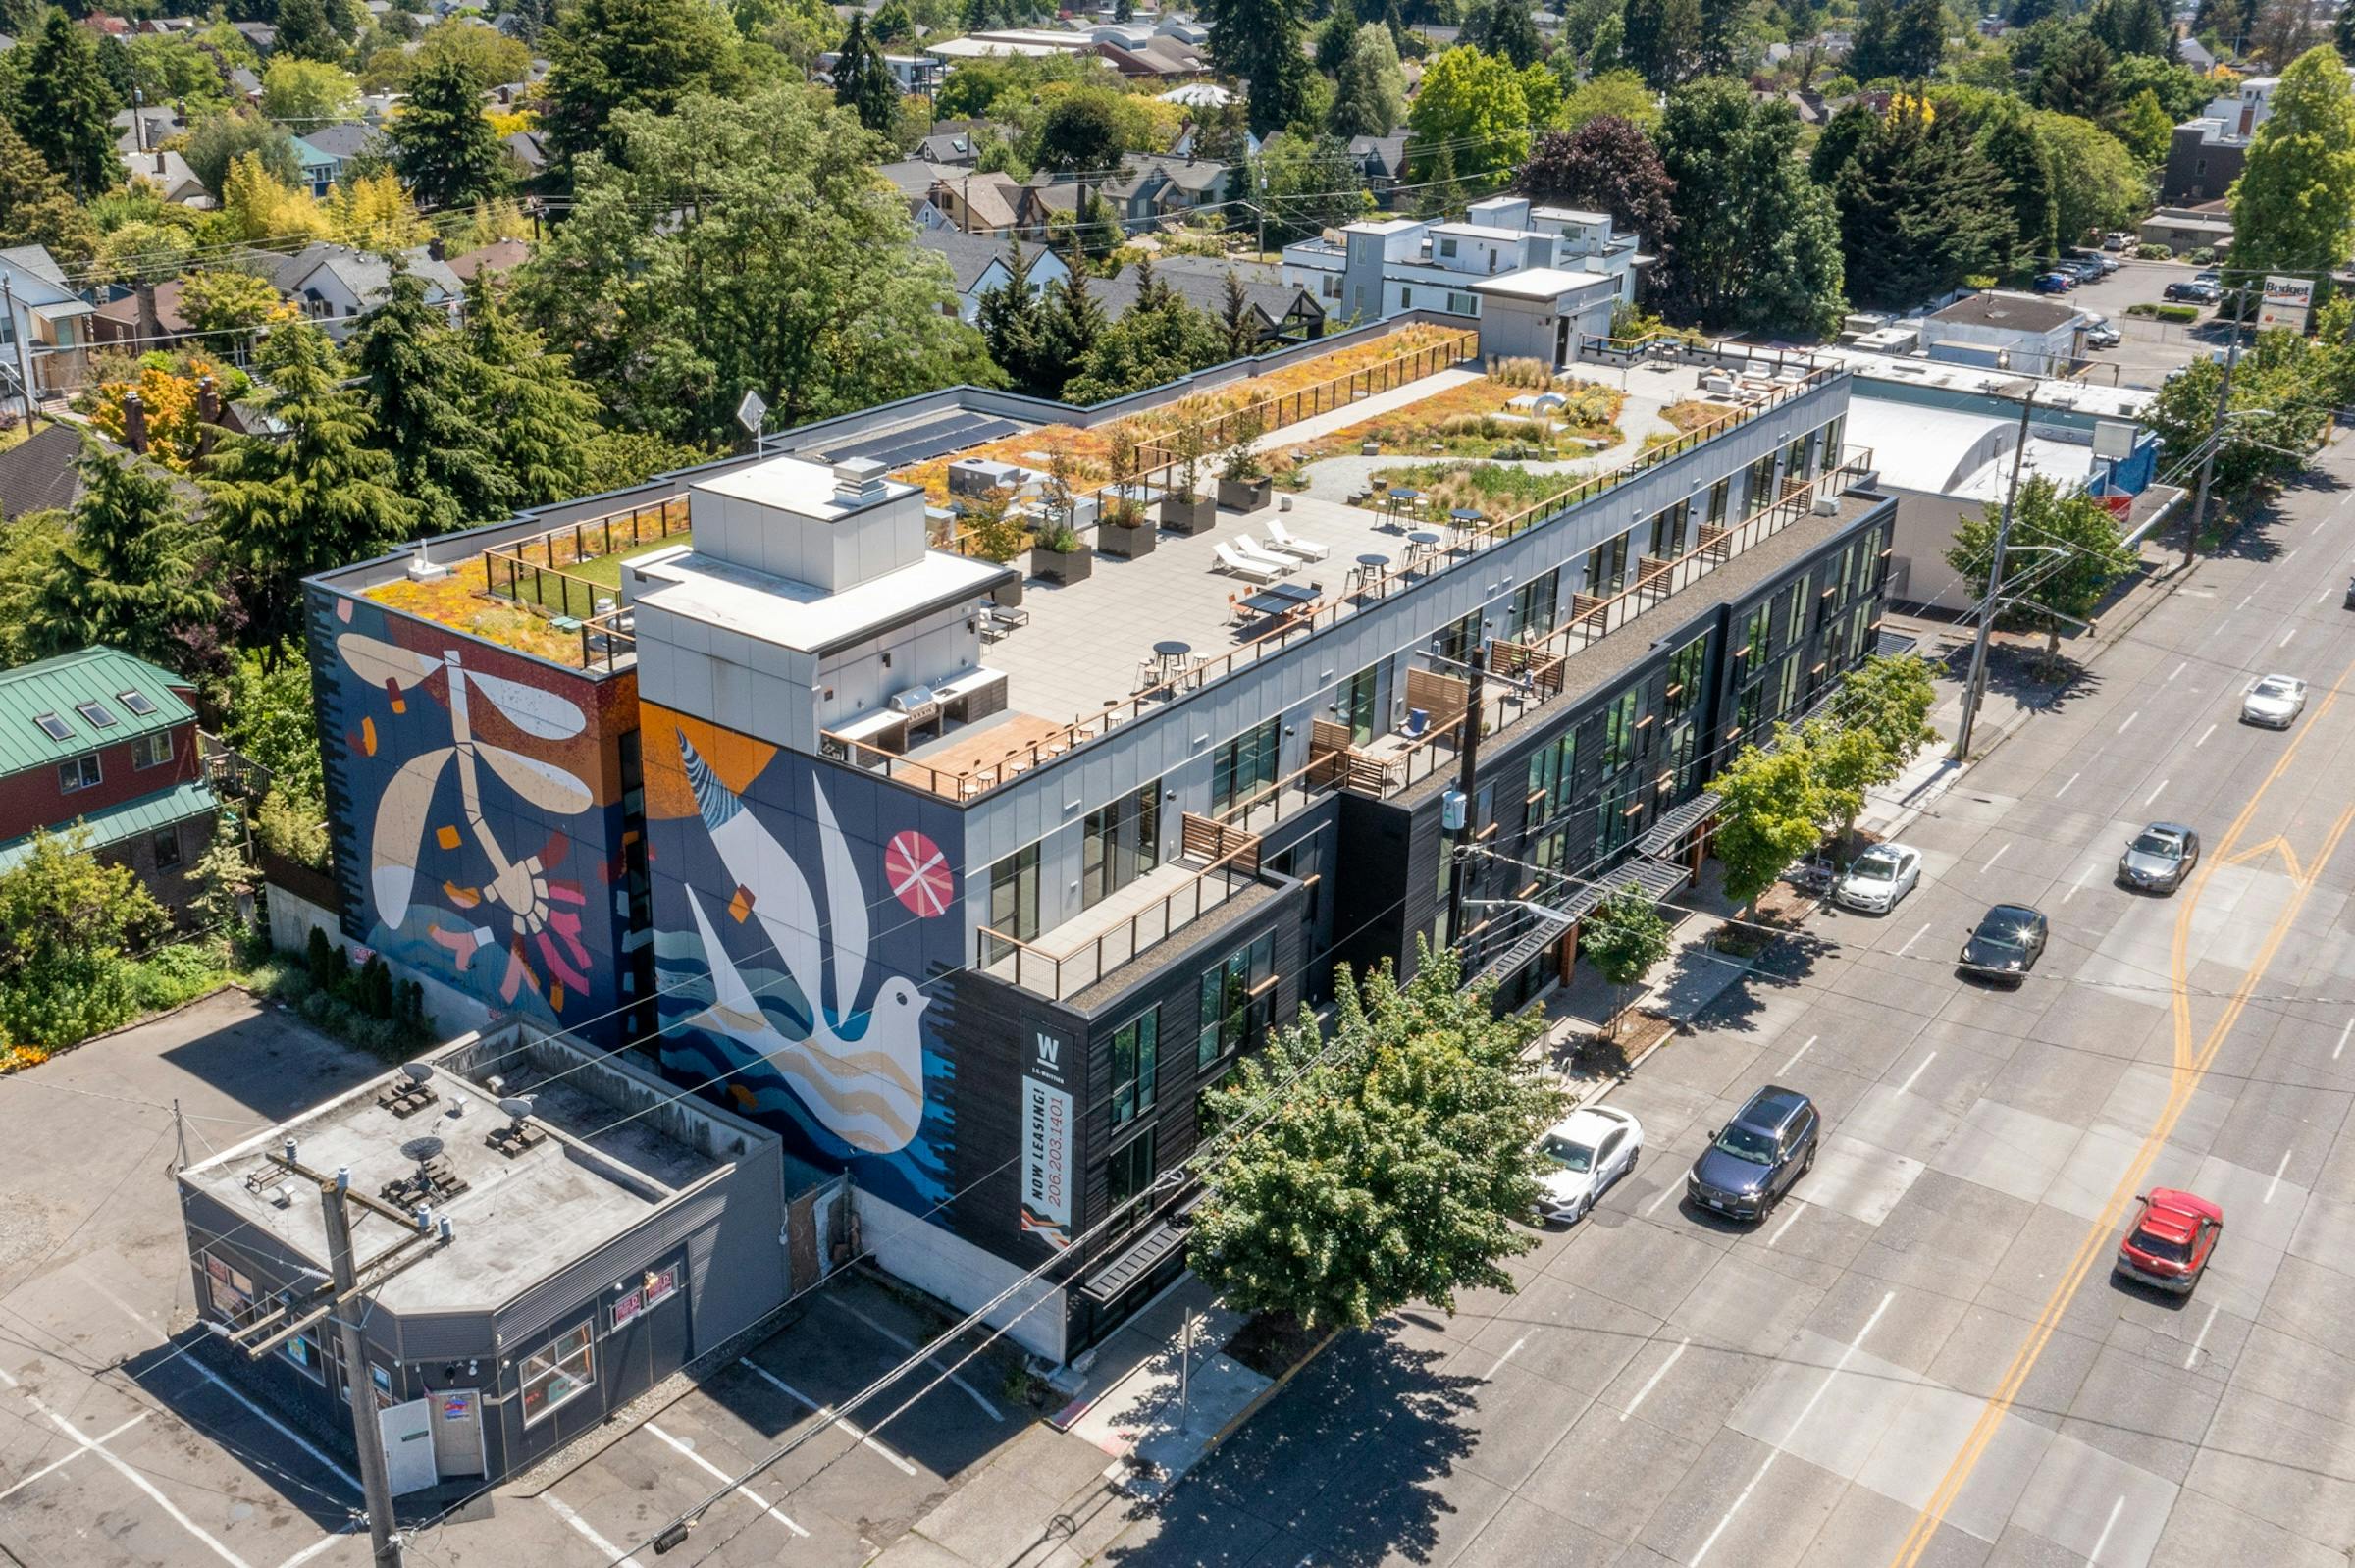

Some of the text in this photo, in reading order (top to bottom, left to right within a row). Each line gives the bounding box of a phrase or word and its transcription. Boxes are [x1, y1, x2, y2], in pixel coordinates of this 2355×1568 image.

[2266, 282, 2309, 297] Budget
[1036, 1032, 1059, 1063] W
[1032, 1087, 1045, 1160] LEASING!
[1048, 1098, 1063, 1208] 206.203.1401
[1032, 1164, 1044, 1200] NOW
